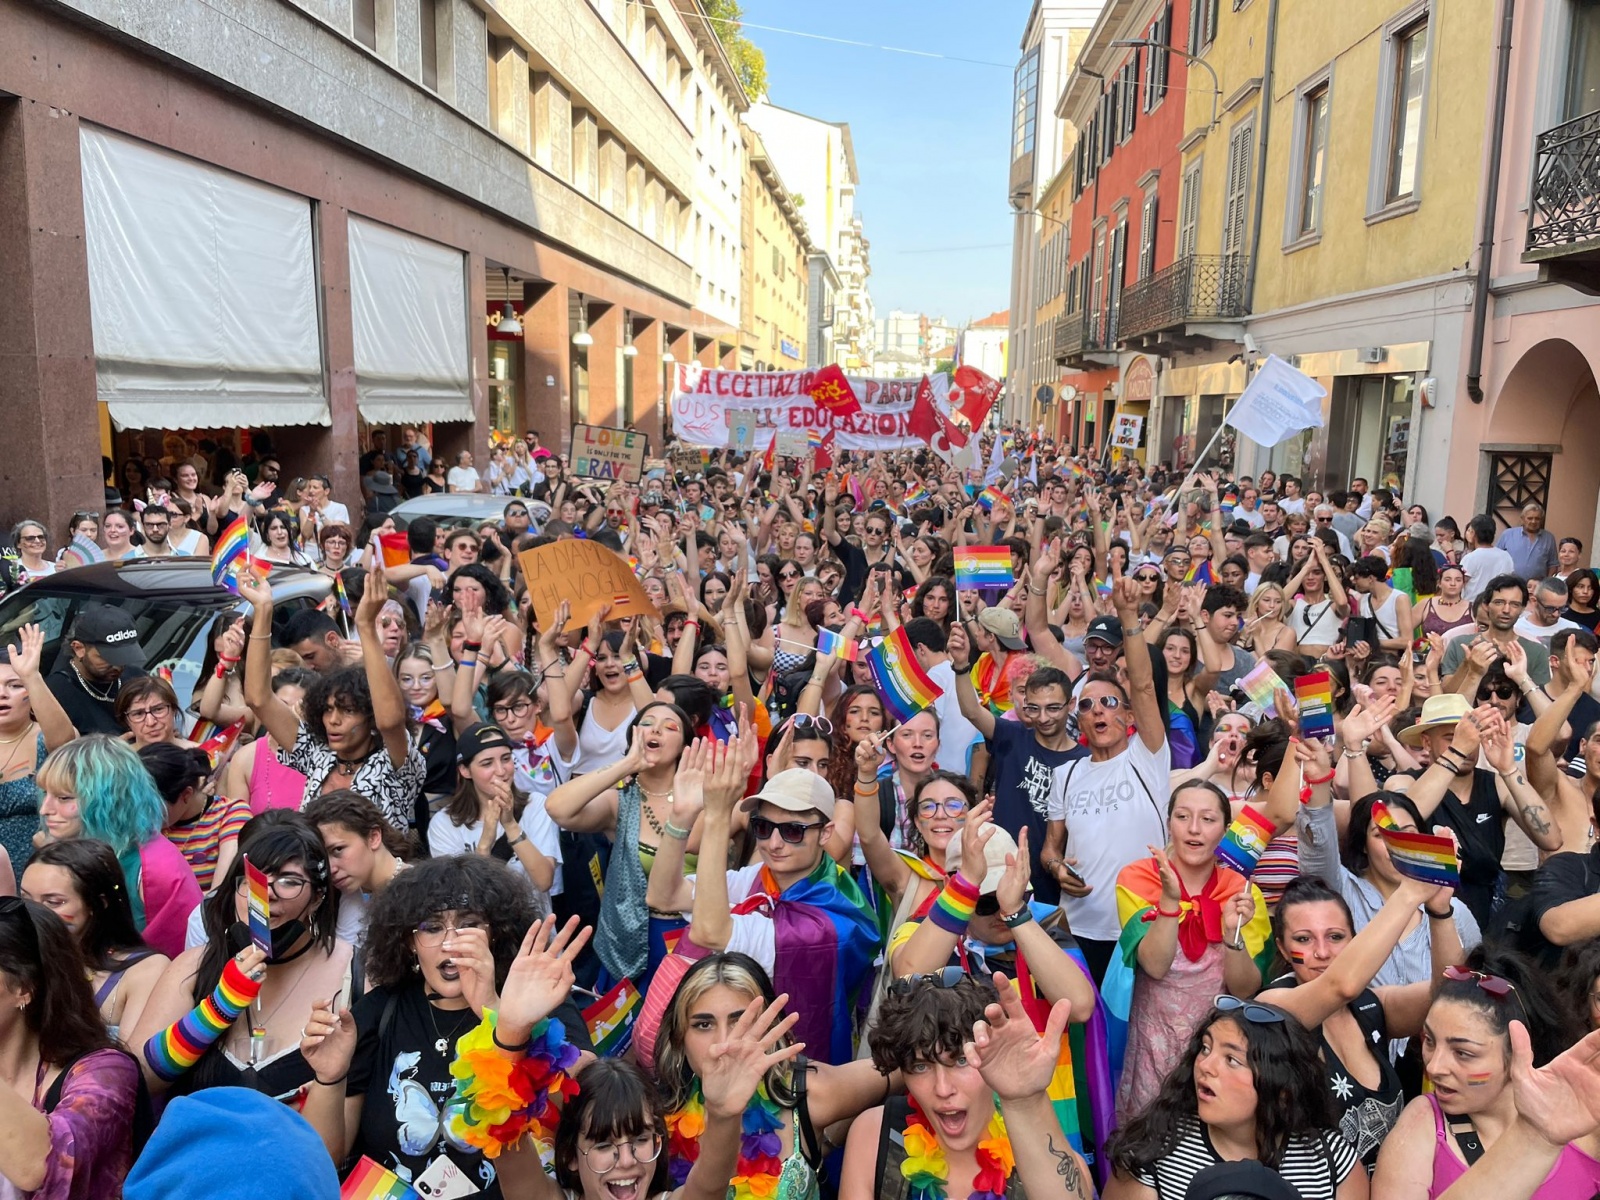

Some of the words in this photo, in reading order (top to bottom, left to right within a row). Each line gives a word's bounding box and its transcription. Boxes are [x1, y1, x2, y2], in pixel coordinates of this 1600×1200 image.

[865, 380, 919, 404] PART
[678, 398, 720, 421] UDS
[584, 427, 636, 448] LOVE
[594, 449, 610, 457] ONLY
[577, 457, 636, 480] BRAVE
[522, 552, 552, 581] LA
[552, 541, 613, 574] DIAMO
[531, 582, 561, 614] CHI
[106, 629, 138, 643] adidas
[1066, 780, 1135, 810] KENZO
[1072, 803, 1119, 816] PARIS
